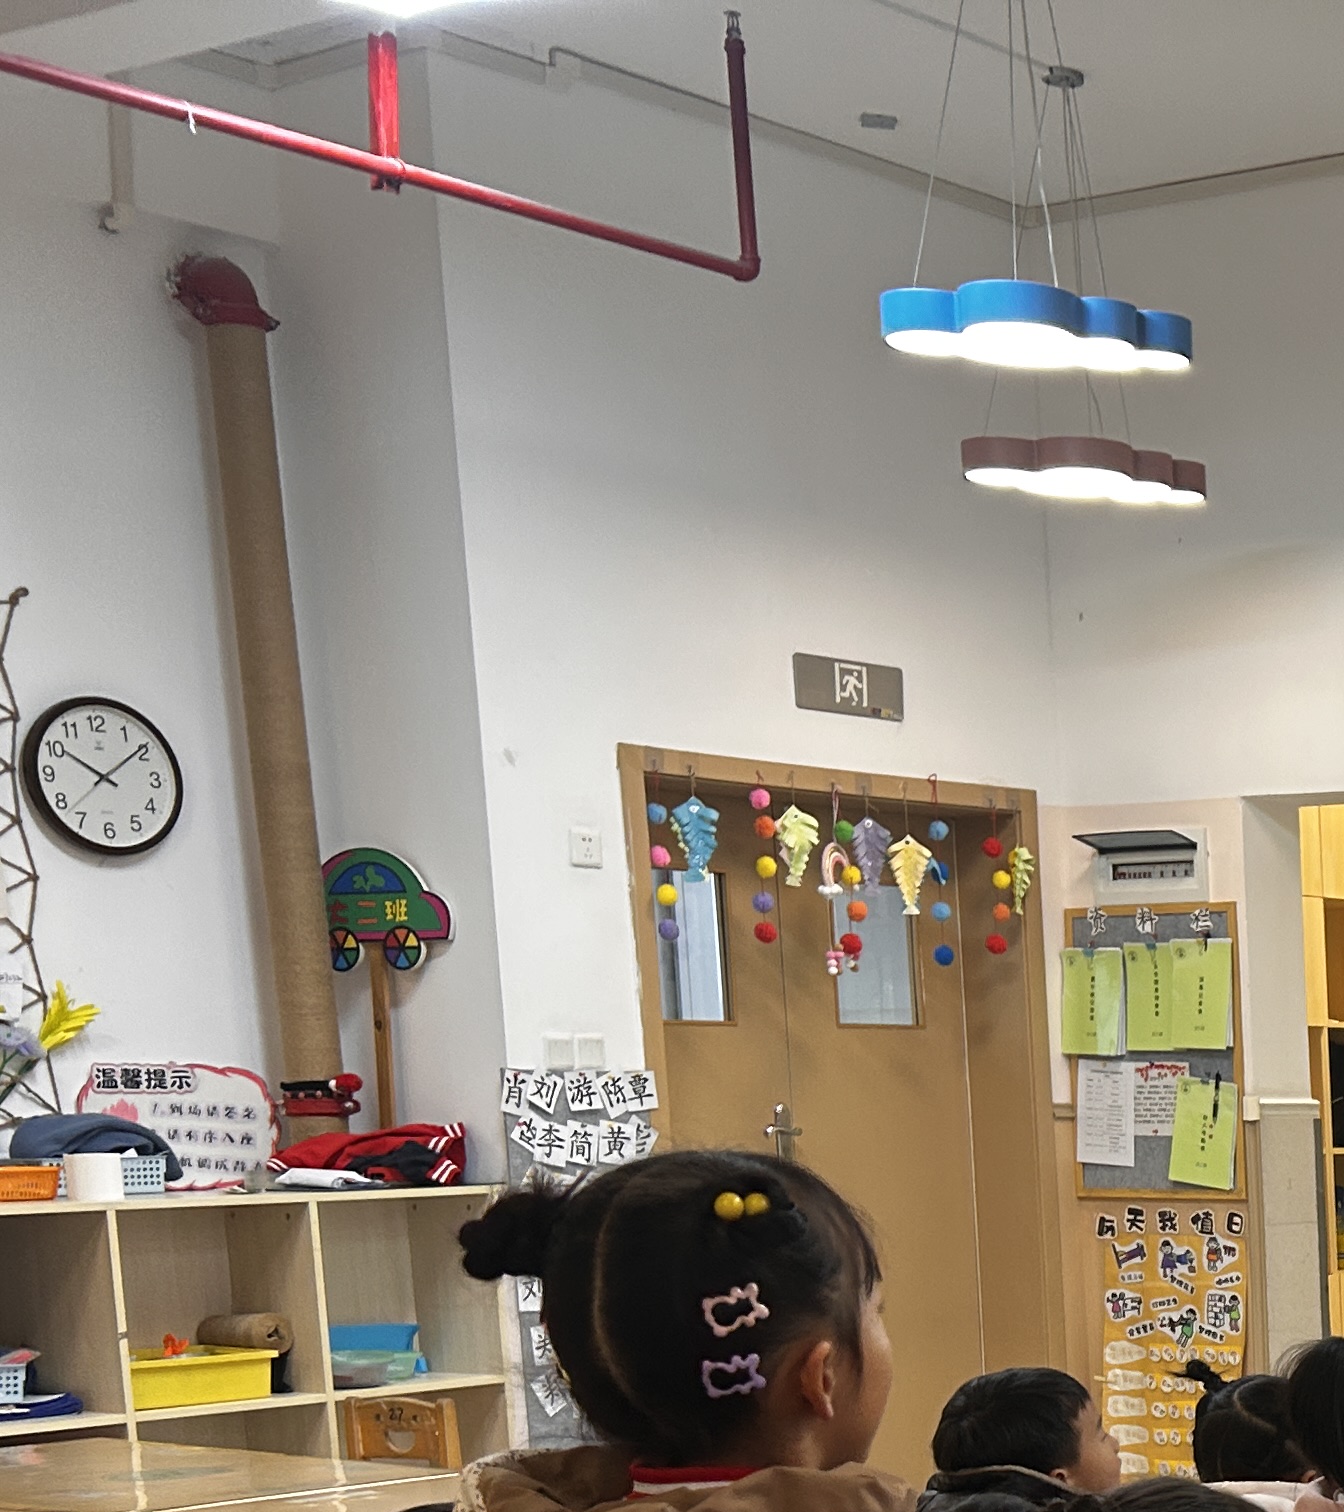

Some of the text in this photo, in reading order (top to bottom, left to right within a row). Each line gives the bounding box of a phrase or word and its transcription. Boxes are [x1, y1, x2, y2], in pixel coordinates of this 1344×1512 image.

[61, 721, 78, 739] 11
[86, 715, 106, 733] 12
[120, 726, 128, 742] 1
[45, 740, 65, 758] 10
[138, 743, 150, 762] 2
[43, 765, 55, 783] 9
[149, 772, 162, 789] 3
[55, 792, 67, 810] 8
[144, 797, 157, 814] 4
[75, 811, 87, 829] 7
[130, 815, 142, 832] 5
[103, 822, 116, 839] 6
[329, 898, 408, 925] 大二班
[95, 1067, 192, 1090] 温馨提示
[505, 1074, 527, 1108] 肖
[530, 1075, 557, 1108] 刘
[567, 1076, 598, 1107] 游
[536, 1124, 565, 1159] 李
[569, 1130, 593, 1163] 简
[601, 1126, 631, 1159] 黄
[388, 1407, 404, 1422] 27
